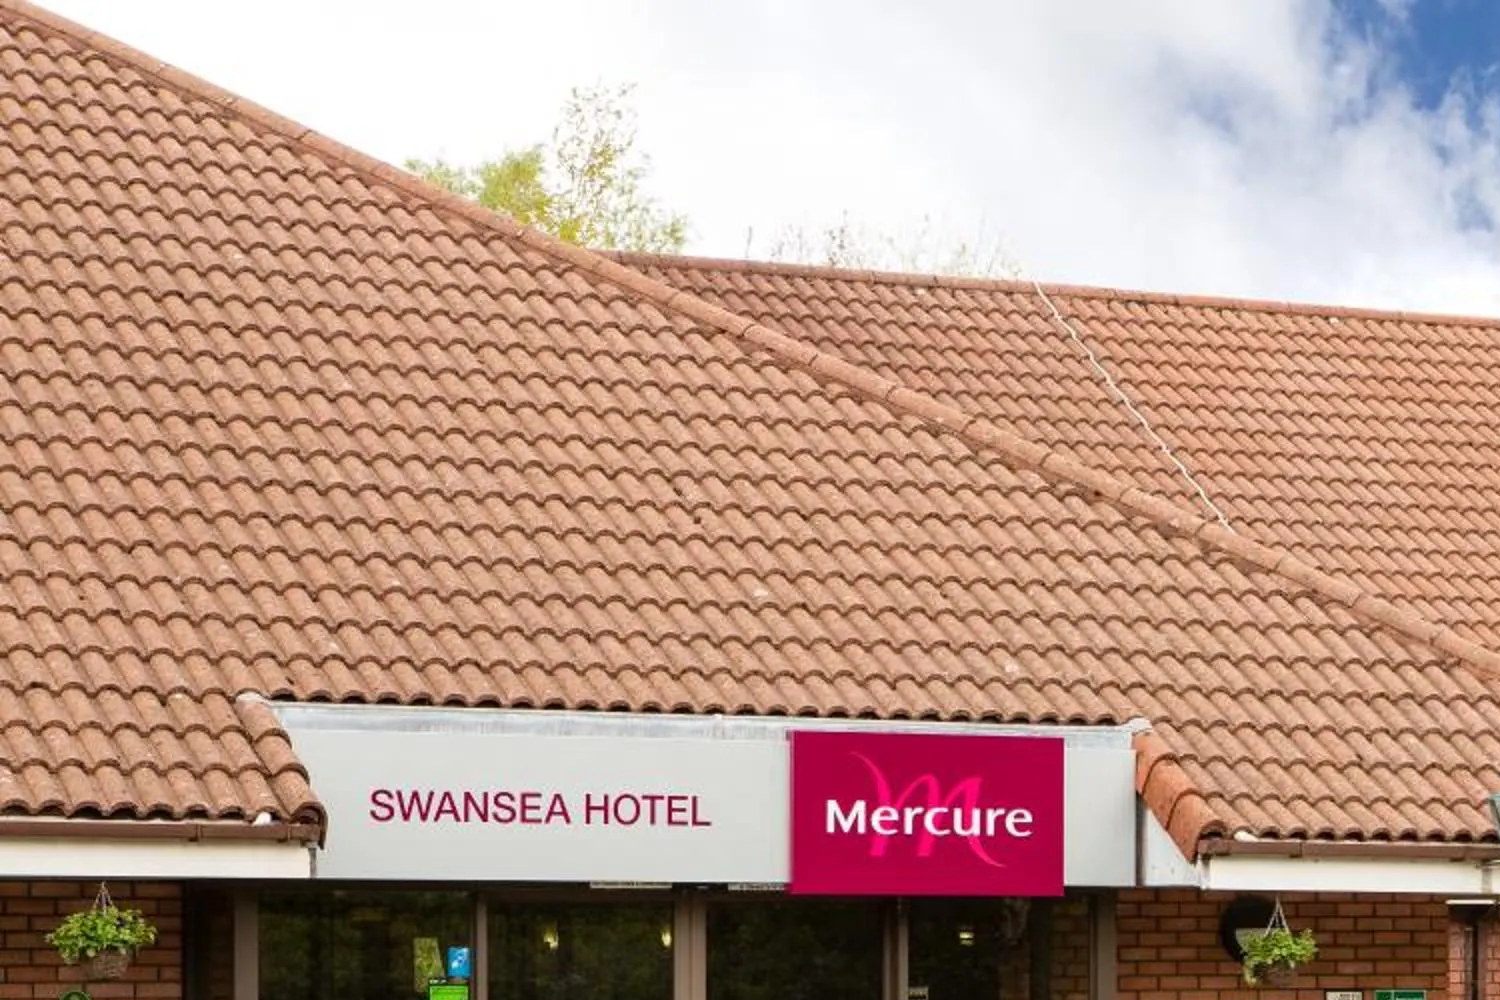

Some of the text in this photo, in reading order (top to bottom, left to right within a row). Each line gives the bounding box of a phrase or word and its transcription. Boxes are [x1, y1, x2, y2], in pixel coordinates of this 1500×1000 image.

[369, 788, 712, 827] SWANSEA HOTEL
[825, 799, 1034, 838] Mercure
